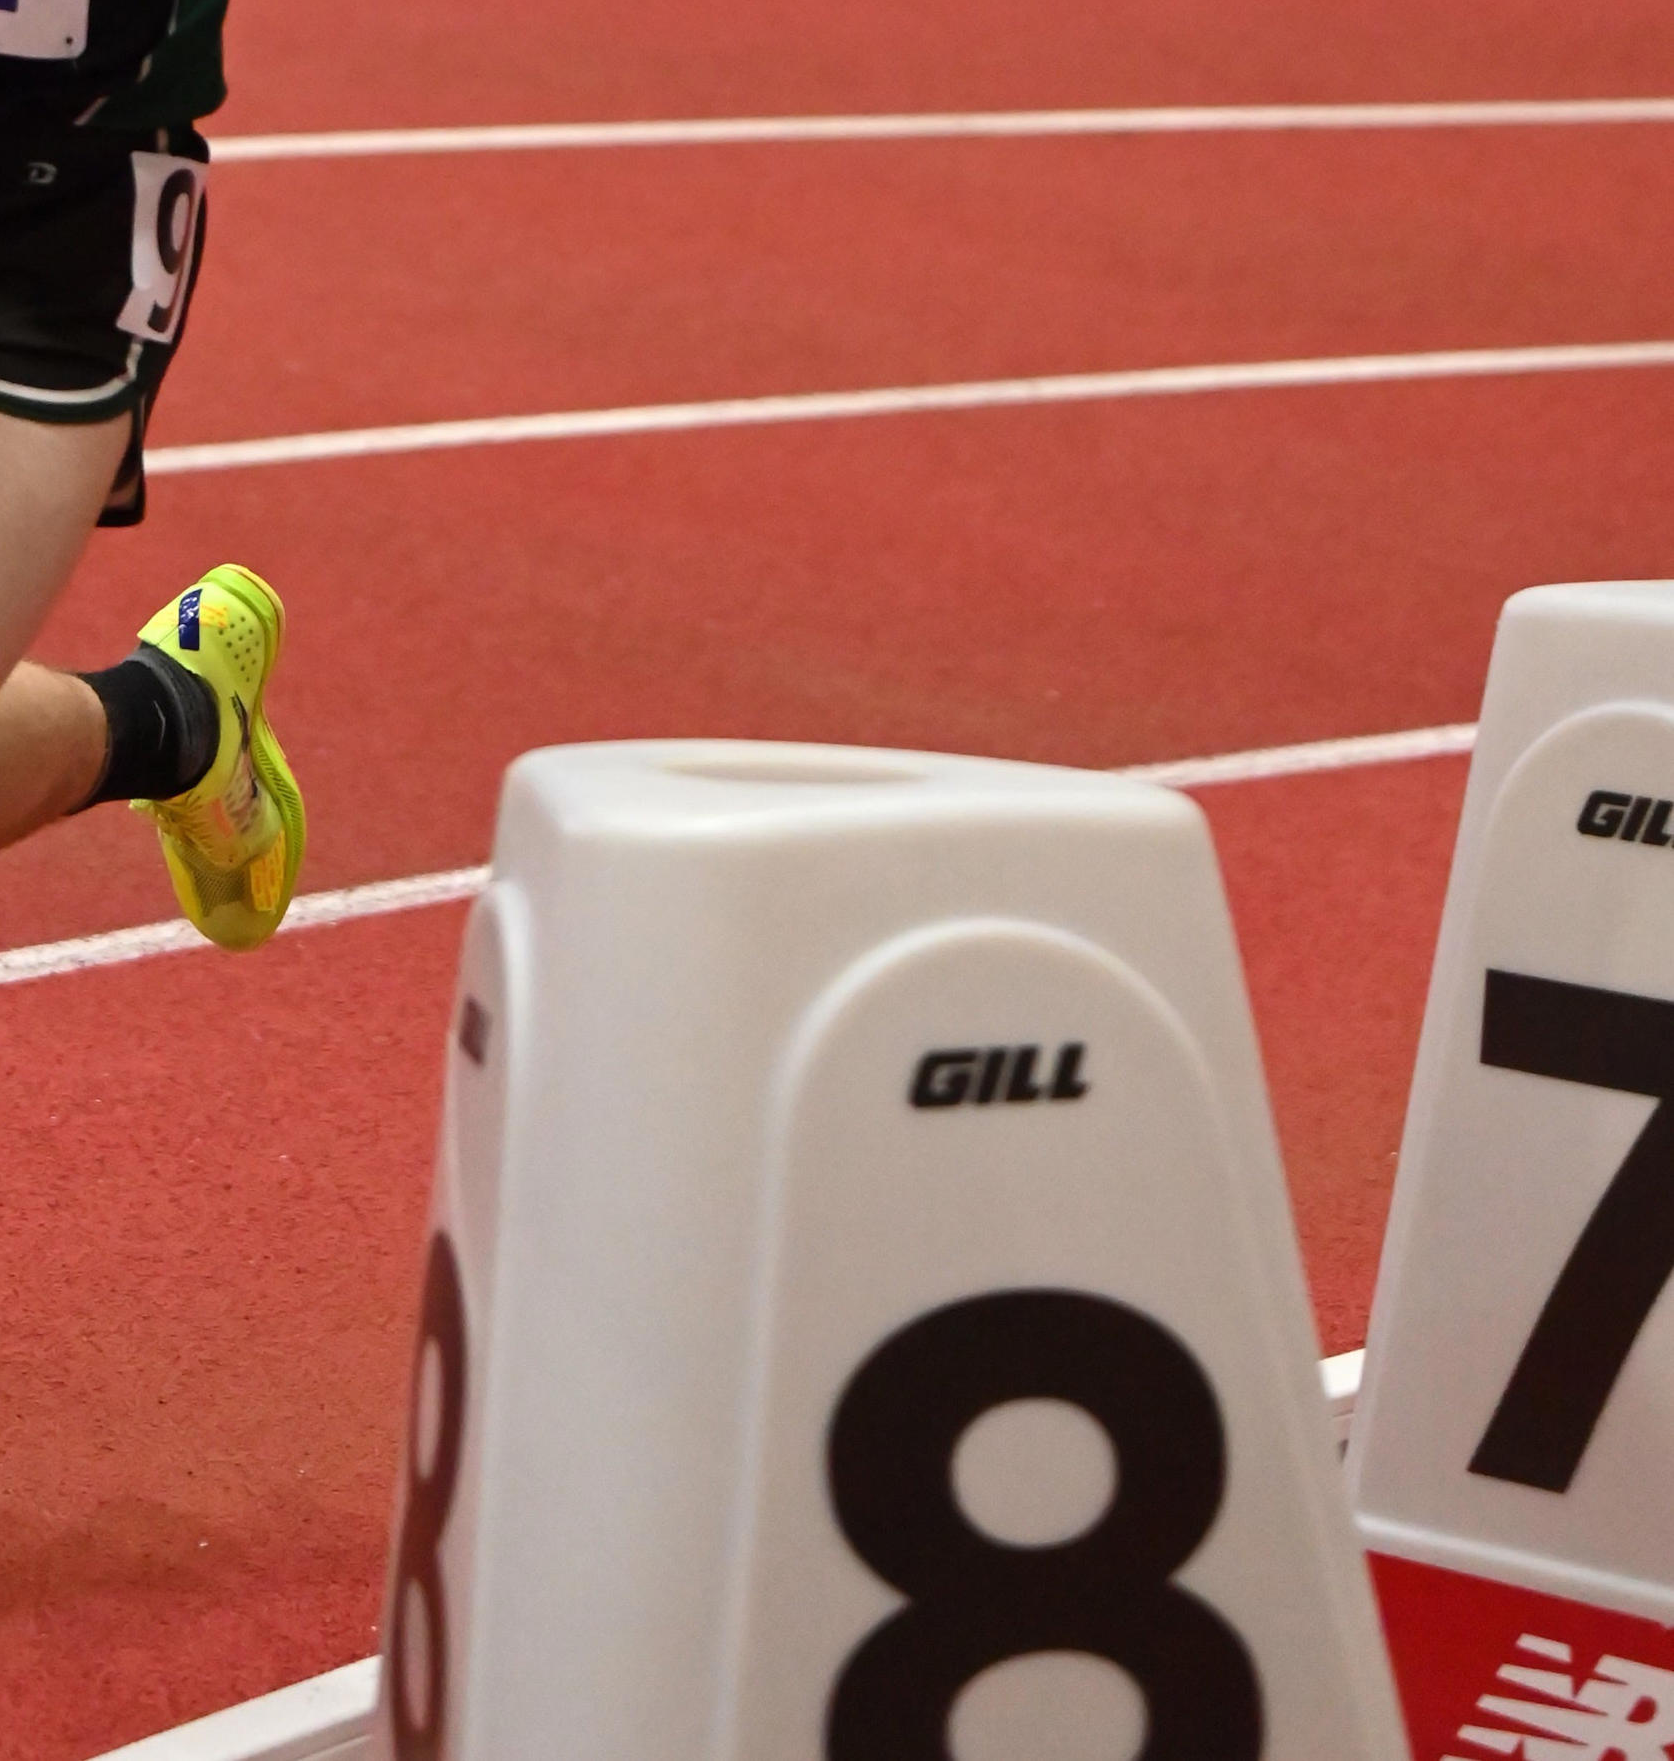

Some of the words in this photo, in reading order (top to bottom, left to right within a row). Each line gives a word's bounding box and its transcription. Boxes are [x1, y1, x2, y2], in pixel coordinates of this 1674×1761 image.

[147, 168, 196, 333] 9
[1576, 789, 1674, 849] GIL
[908, 1041, 1091, 1109] GILL
[1468, 967, 1674, 1493] 7
[824, 1286, 1266, 1761] 8
